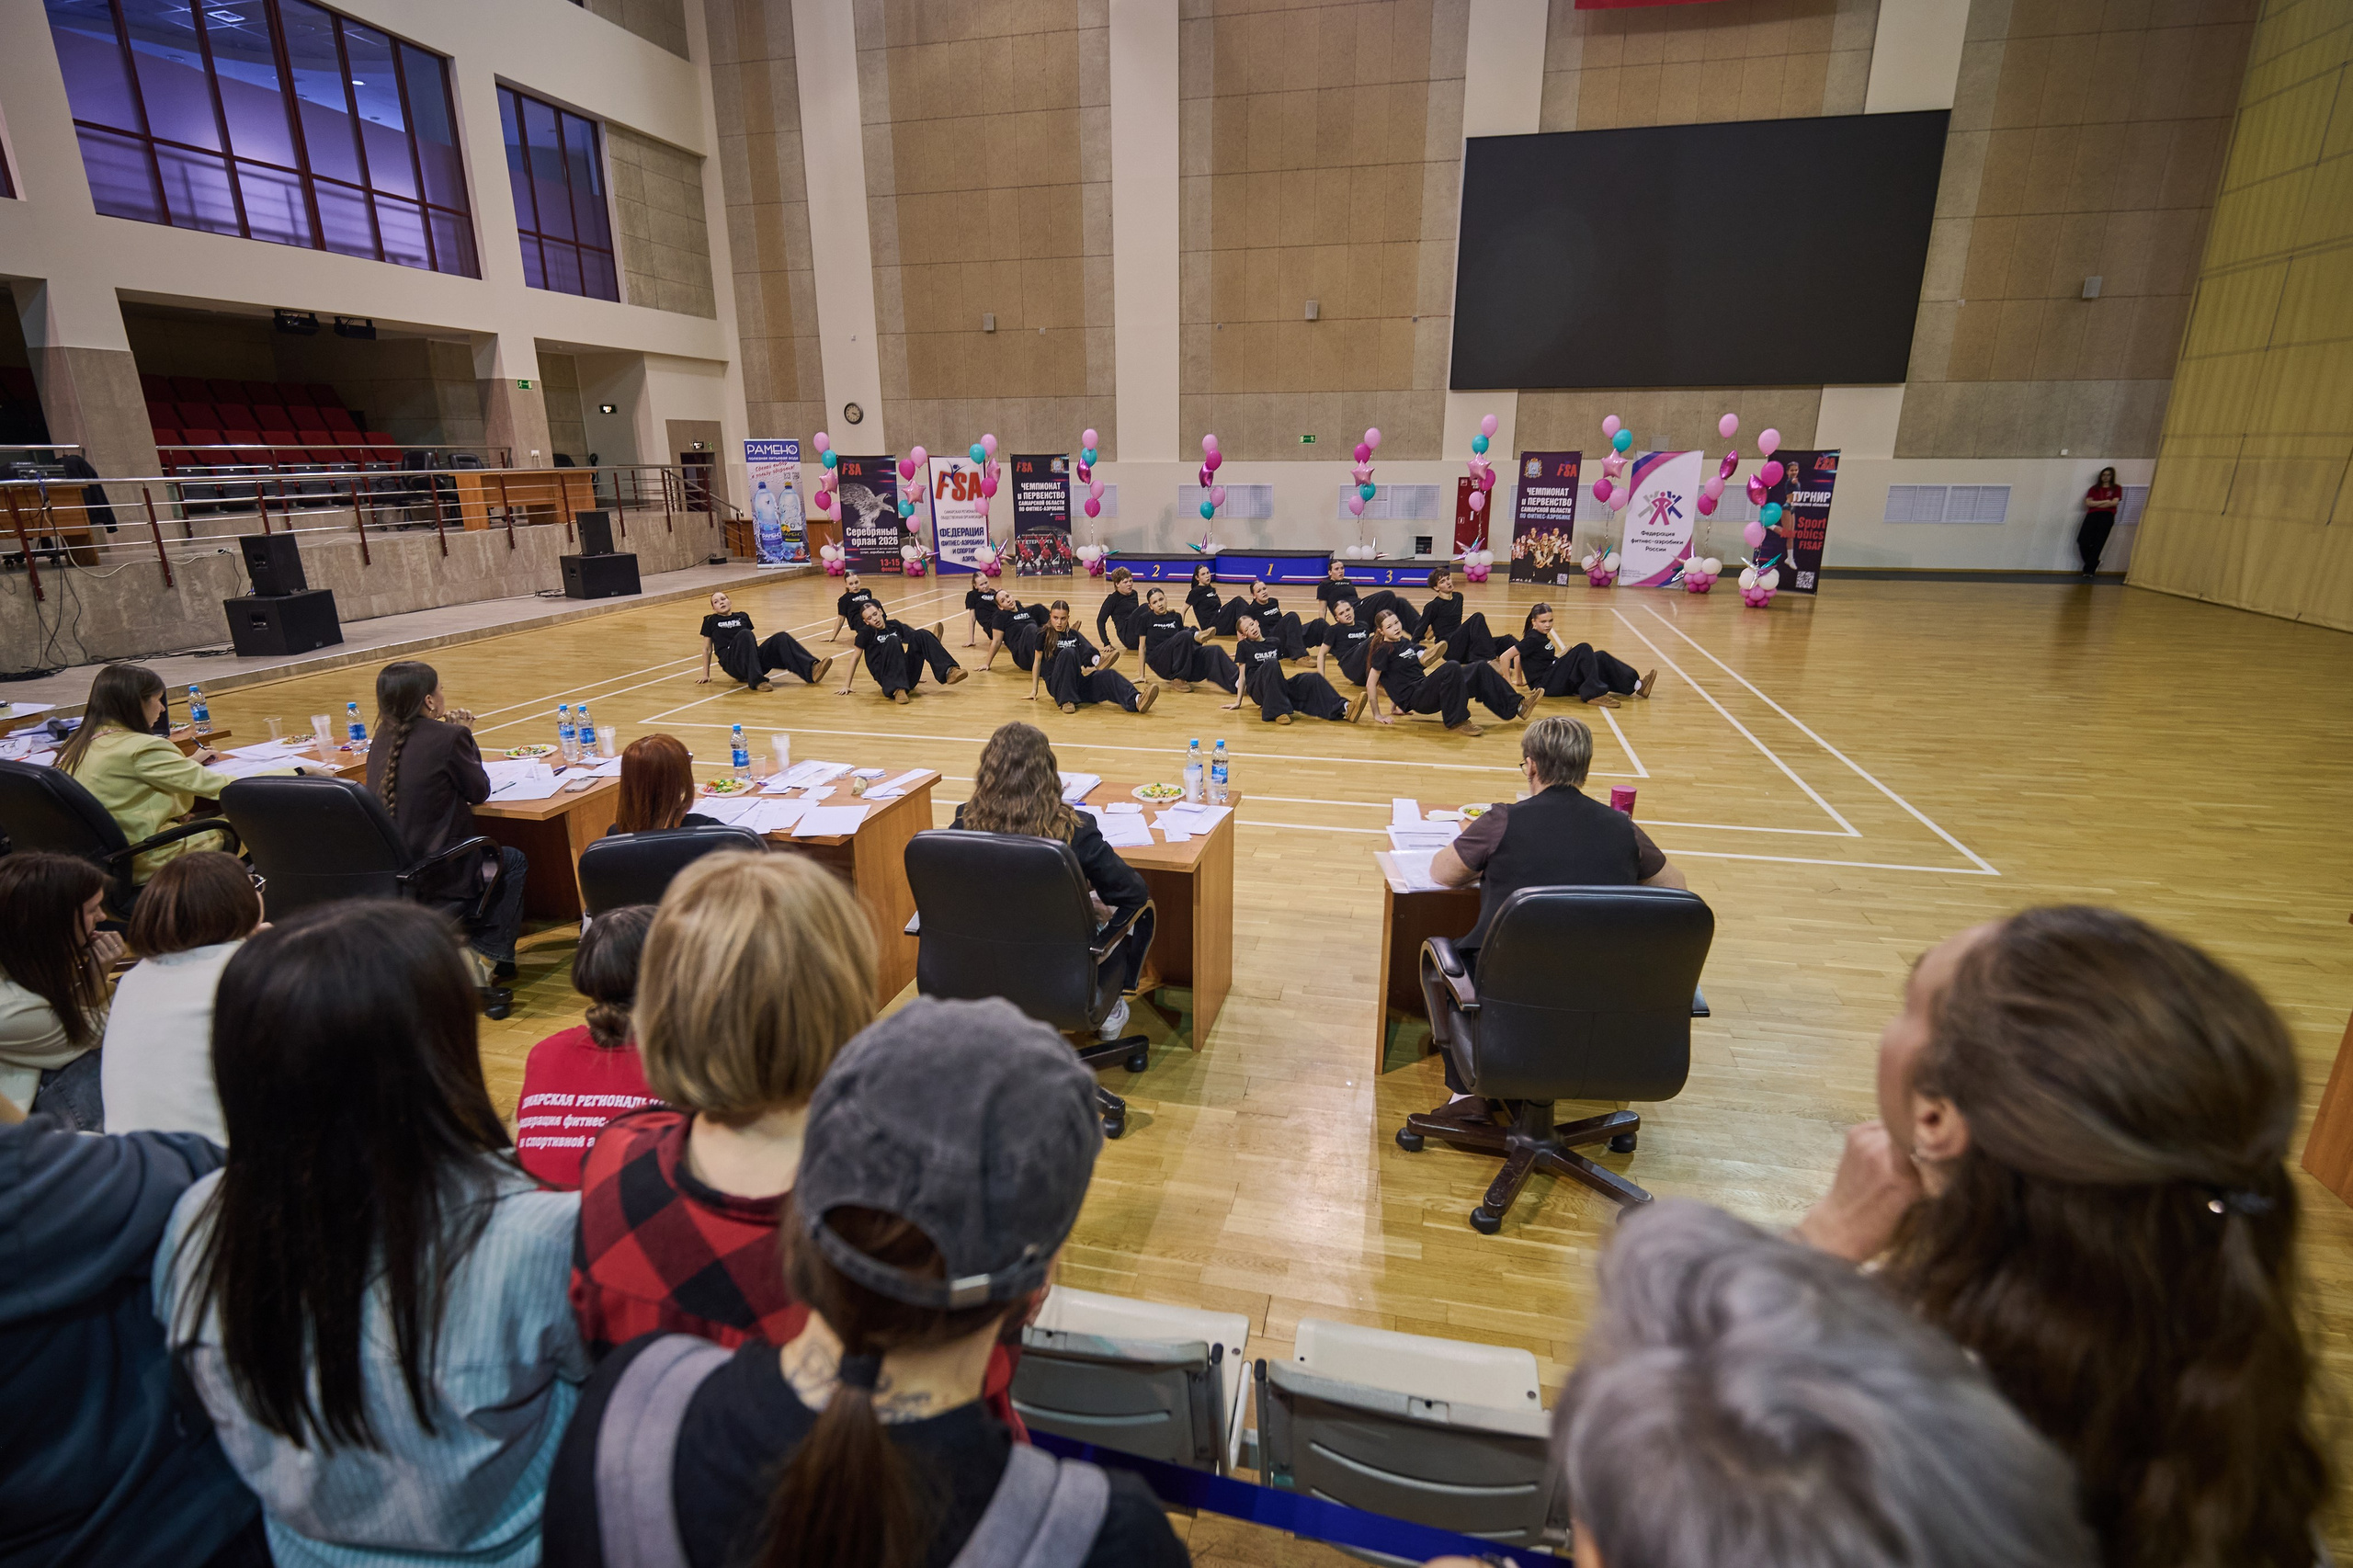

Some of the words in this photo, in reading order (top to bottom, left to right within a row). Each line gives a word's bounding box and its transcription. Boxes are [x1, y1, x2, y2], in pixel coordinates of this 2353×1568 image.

[746, 444, 798, 455] РАМЕНО
[842, 462, 862, 475] FSA
[1016, 461, 1033, 472] FSA
[1813, 457, 1836, 471] FSA
[1556, 463, 1577, 477] FSA
[935, 471, 983, 501] FSA
[1020, 482, 1061, 491] ЧЕМПИОНАТ
[1527, 487, 1570, 496] ЧЕМПИОНАТ
[1023, 491, 1065, 499] ПЕРВЕНСТВО
[1791, 491, 1832, 503] ТУРНИР
[1527, 497, 1573, 506] ПЕРВЕНСТВО
[1797, 517, 1827, 530] Sport
[846, 527, 898, 538] Серебряный
[939, 527, 984, 538] ФЕДЕРАЦИЯ
[851, 538, 877, 547] орлан
[878, 536, 899, 545] 2026
[1799, 540, 1823, 551] FISAF
[880, 558, 901, 566] 13-15
[1152, 564, 1160, 577] 2
[1266, 563, 1274, 575] 1
[1384, 570, 1392, 584] 3
[525, 1135, 585, 1150] спортивной
